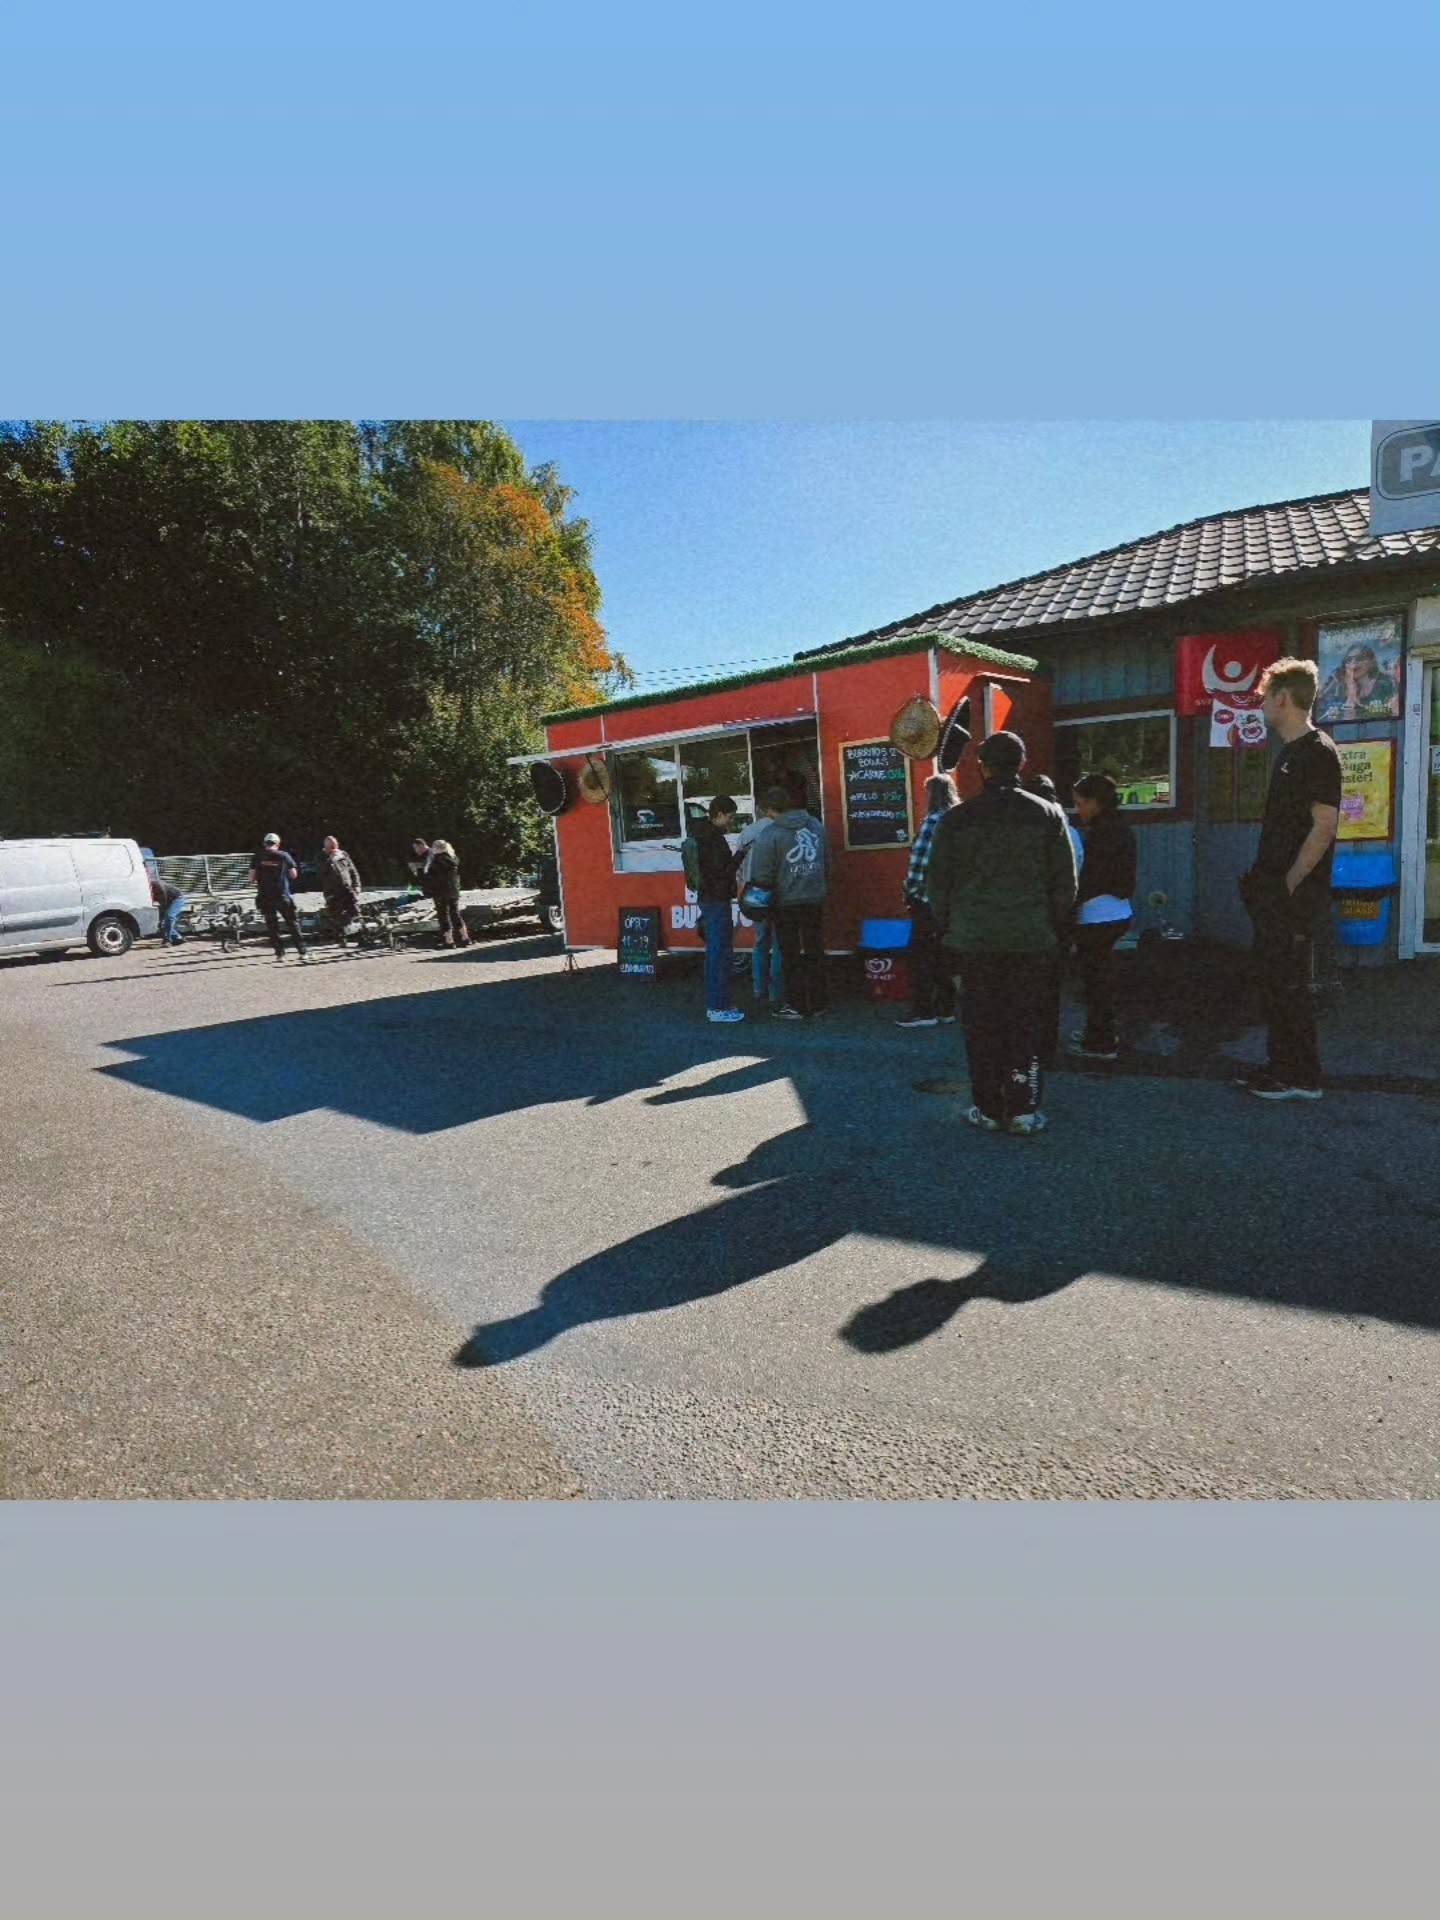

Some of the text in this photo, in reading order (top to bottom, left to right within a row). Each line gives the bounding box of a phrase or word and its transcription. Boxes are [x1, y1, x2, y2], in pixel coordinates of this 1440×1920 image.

[1338, 749, 1366, 760] xtra
[858, 758, 889, 768] BOWLS
[1341, 761, 1371, 774] ånga
